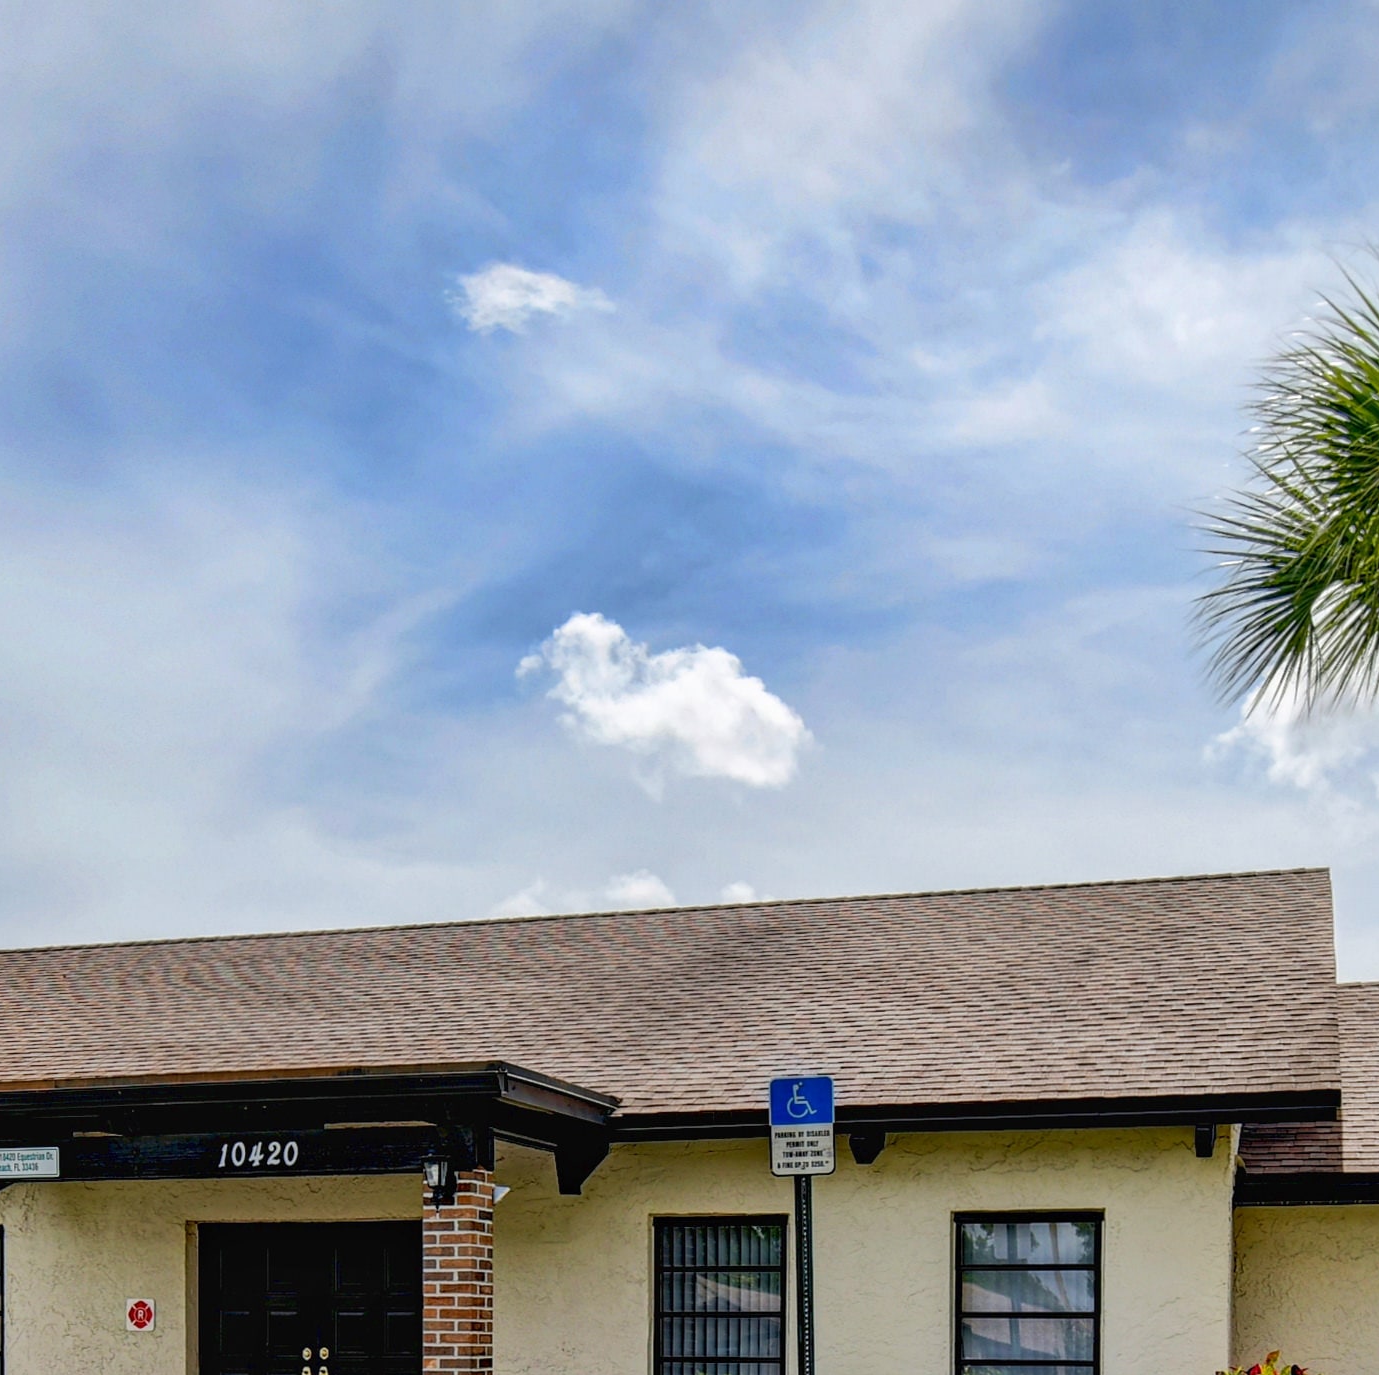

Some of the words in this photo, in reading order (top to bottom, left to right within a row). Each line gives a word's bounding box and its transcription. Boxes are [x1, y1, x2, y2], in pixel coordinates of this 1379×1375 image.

[17, 1152, 45, 1162] Equestrian
[218, 1141, 299, 1168] 10420
[14, 1163, 20, 1171] FL
[137, 1309, 144, 1320] R
